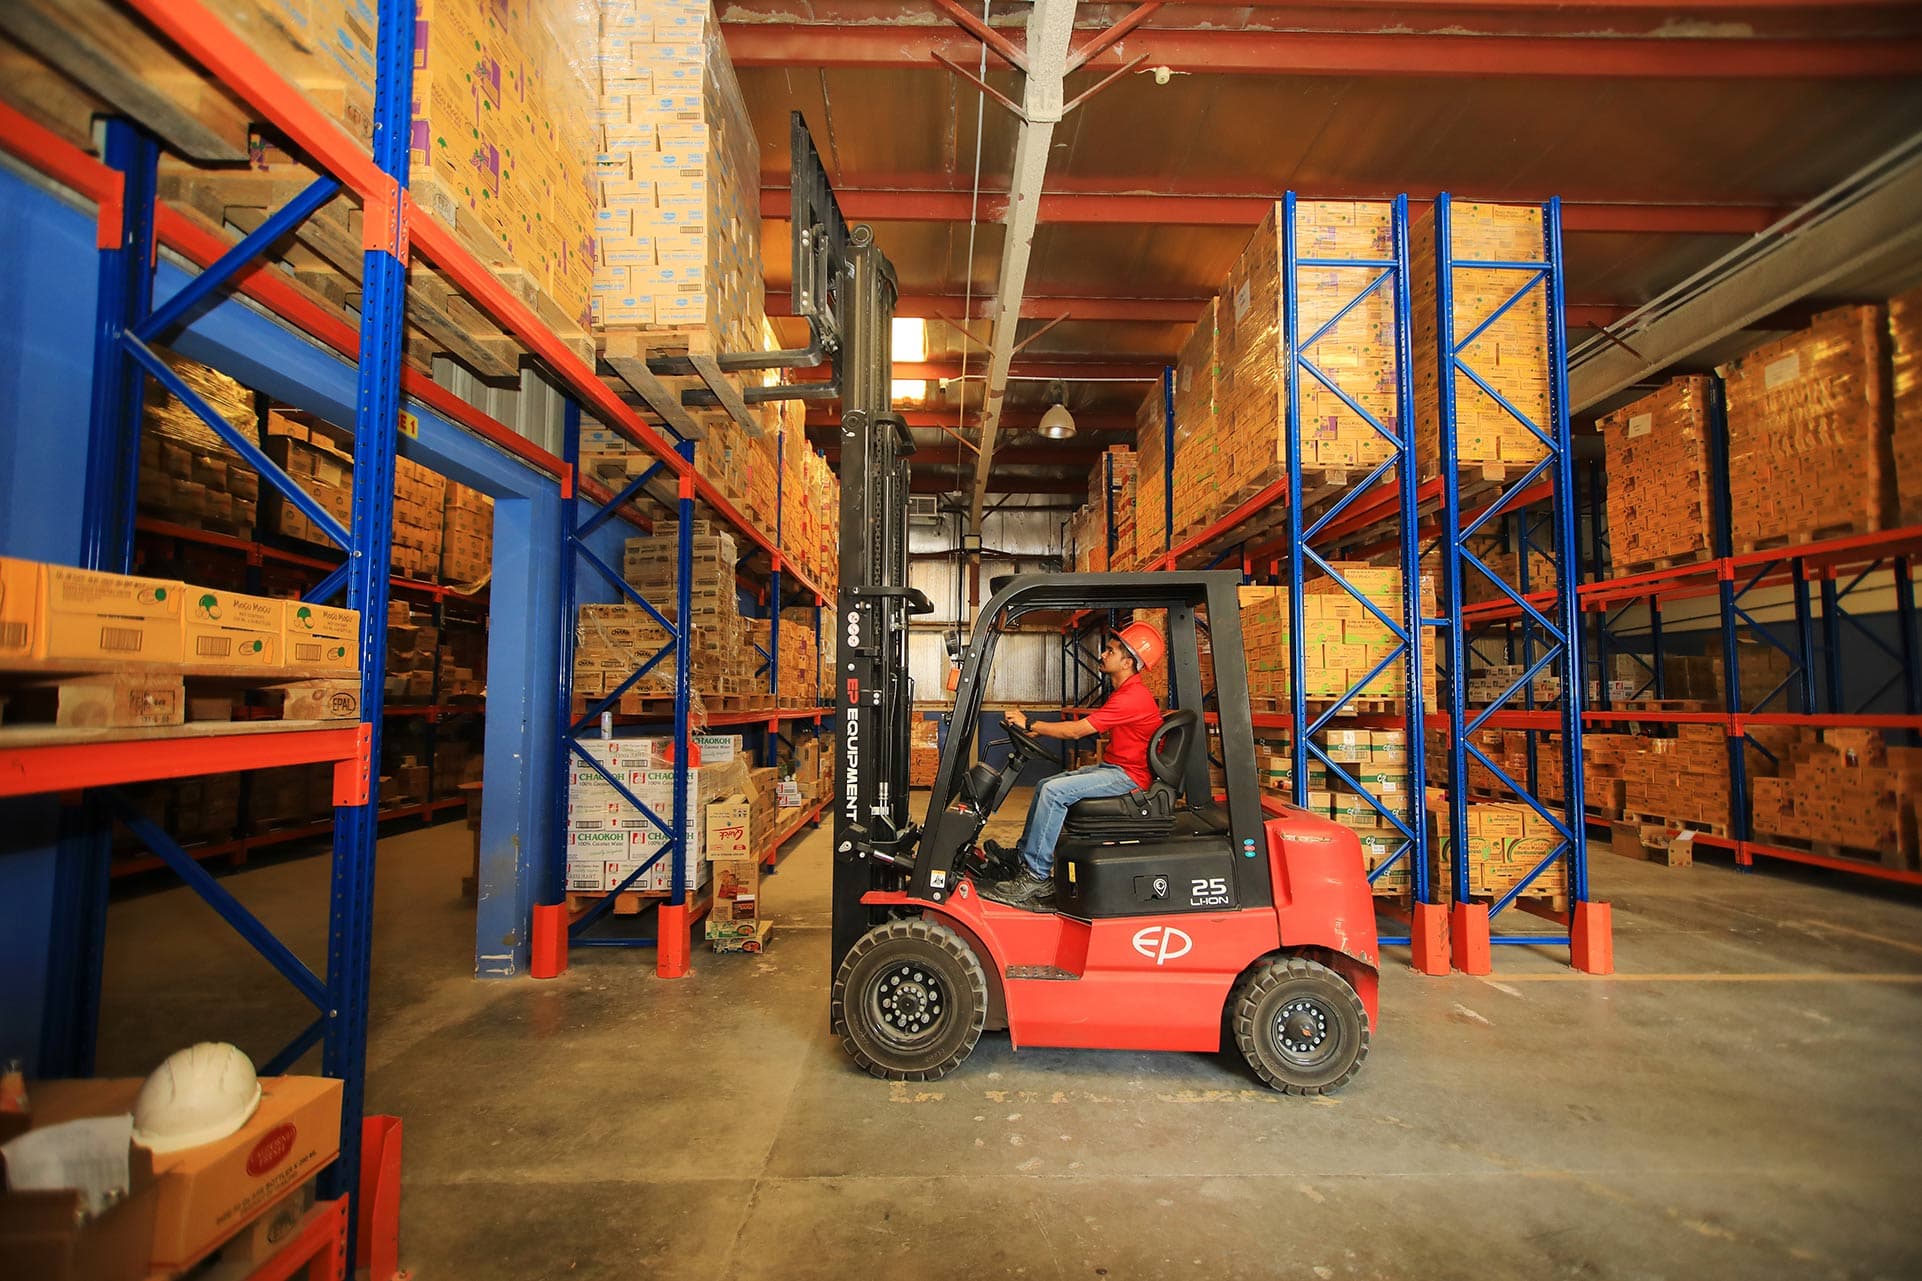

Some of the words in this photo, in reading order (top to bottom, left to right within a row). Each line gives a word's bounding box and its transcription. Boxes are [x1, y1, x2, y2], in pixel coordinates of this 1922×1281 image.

[410, 420, 416, 434] 1
[847, 678, 859, 704] EP
[332, 697, 353, 712] EPAL
[846, 708, 859, 822] EQUIPMENT
[648, 772, 694, 780] CHAOH
[577, 833, 624, 841] CHAOKOH
[648, 832, 694, 840] CHAH
[1191, 878, 1227, 896] 25
[1190, 896, 1229, 906] LI-ION
[1132, 926, 1193, 965] EP
